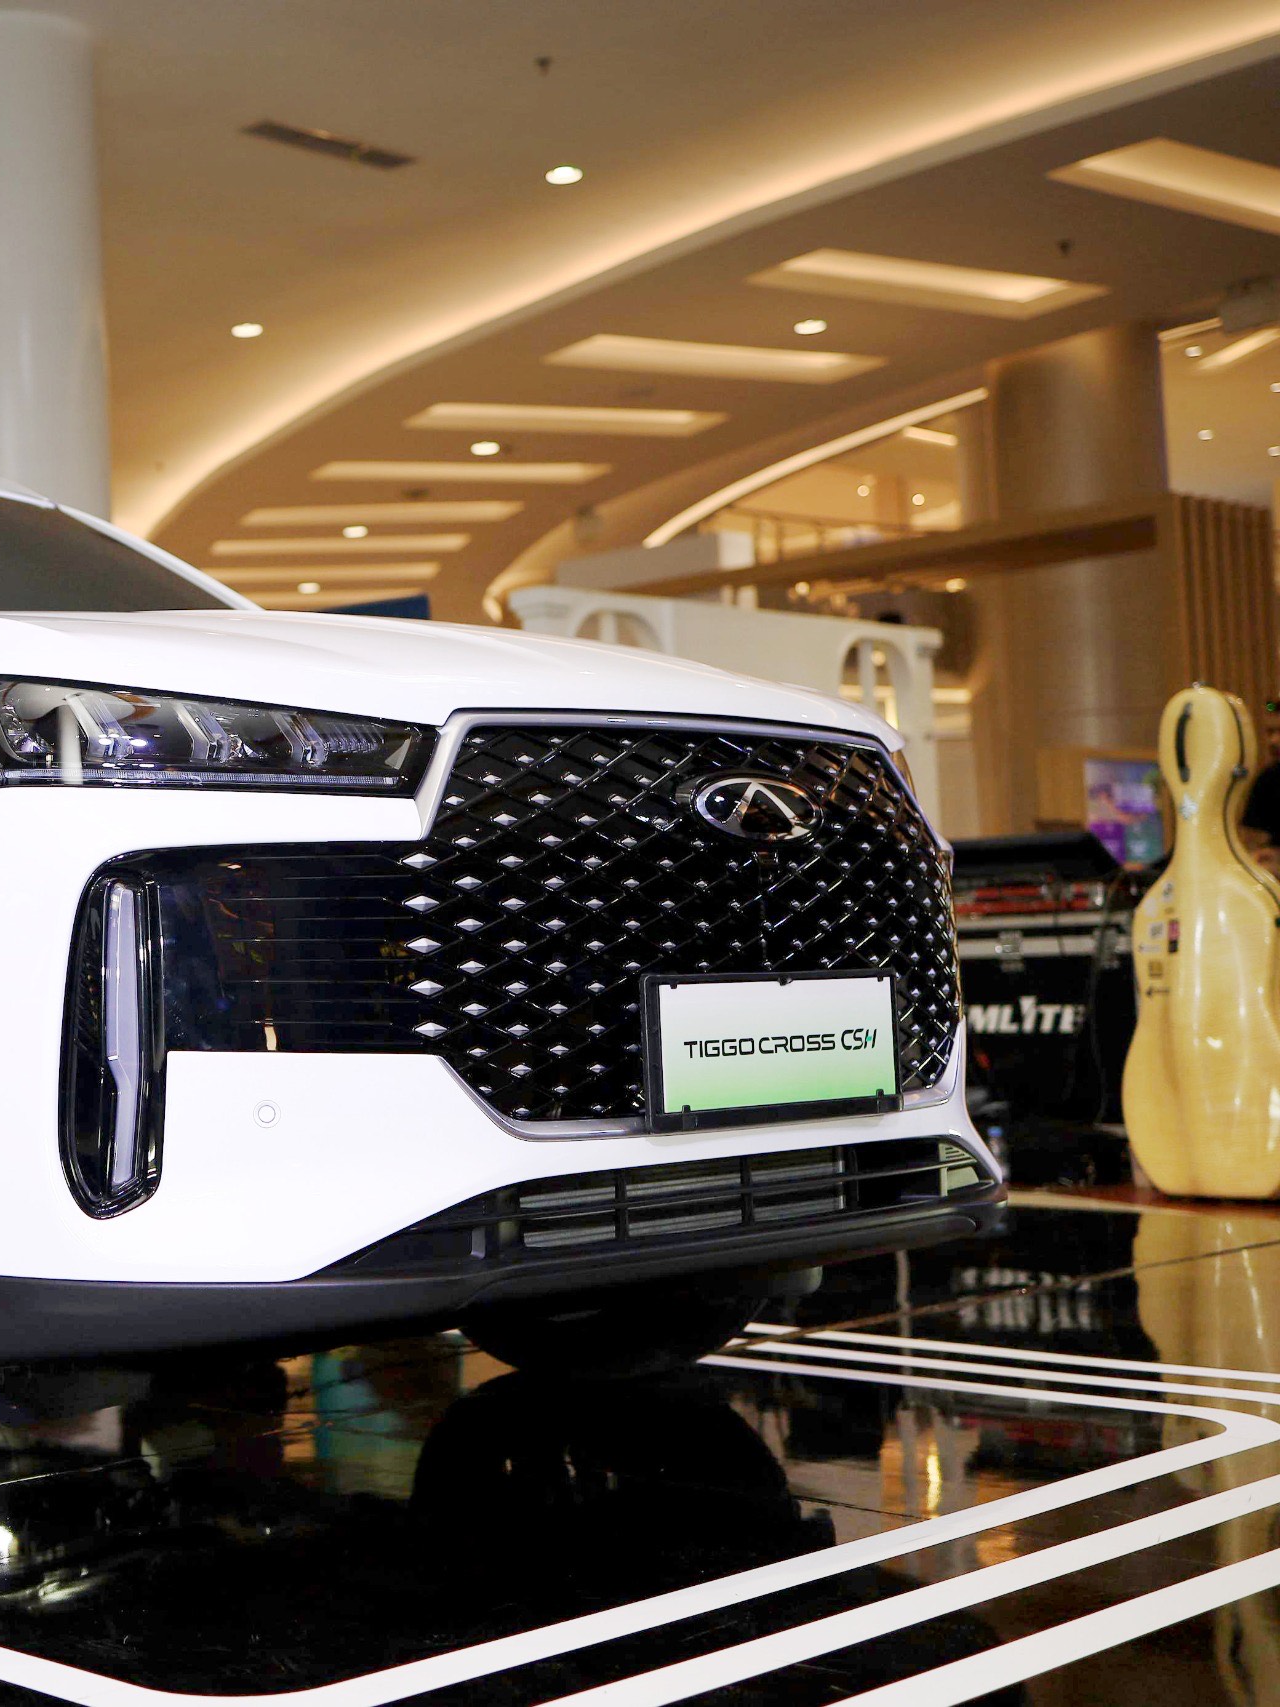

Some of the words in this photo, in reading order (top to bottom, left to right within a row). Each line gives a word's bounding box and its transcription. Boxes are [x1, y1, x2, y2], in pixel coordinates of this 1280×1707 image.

[683, 1037, 755, 1059] TIGGO
[758, 1033, 836, 1054] CROSS
[840, 1028, 878, 1051] CSH
